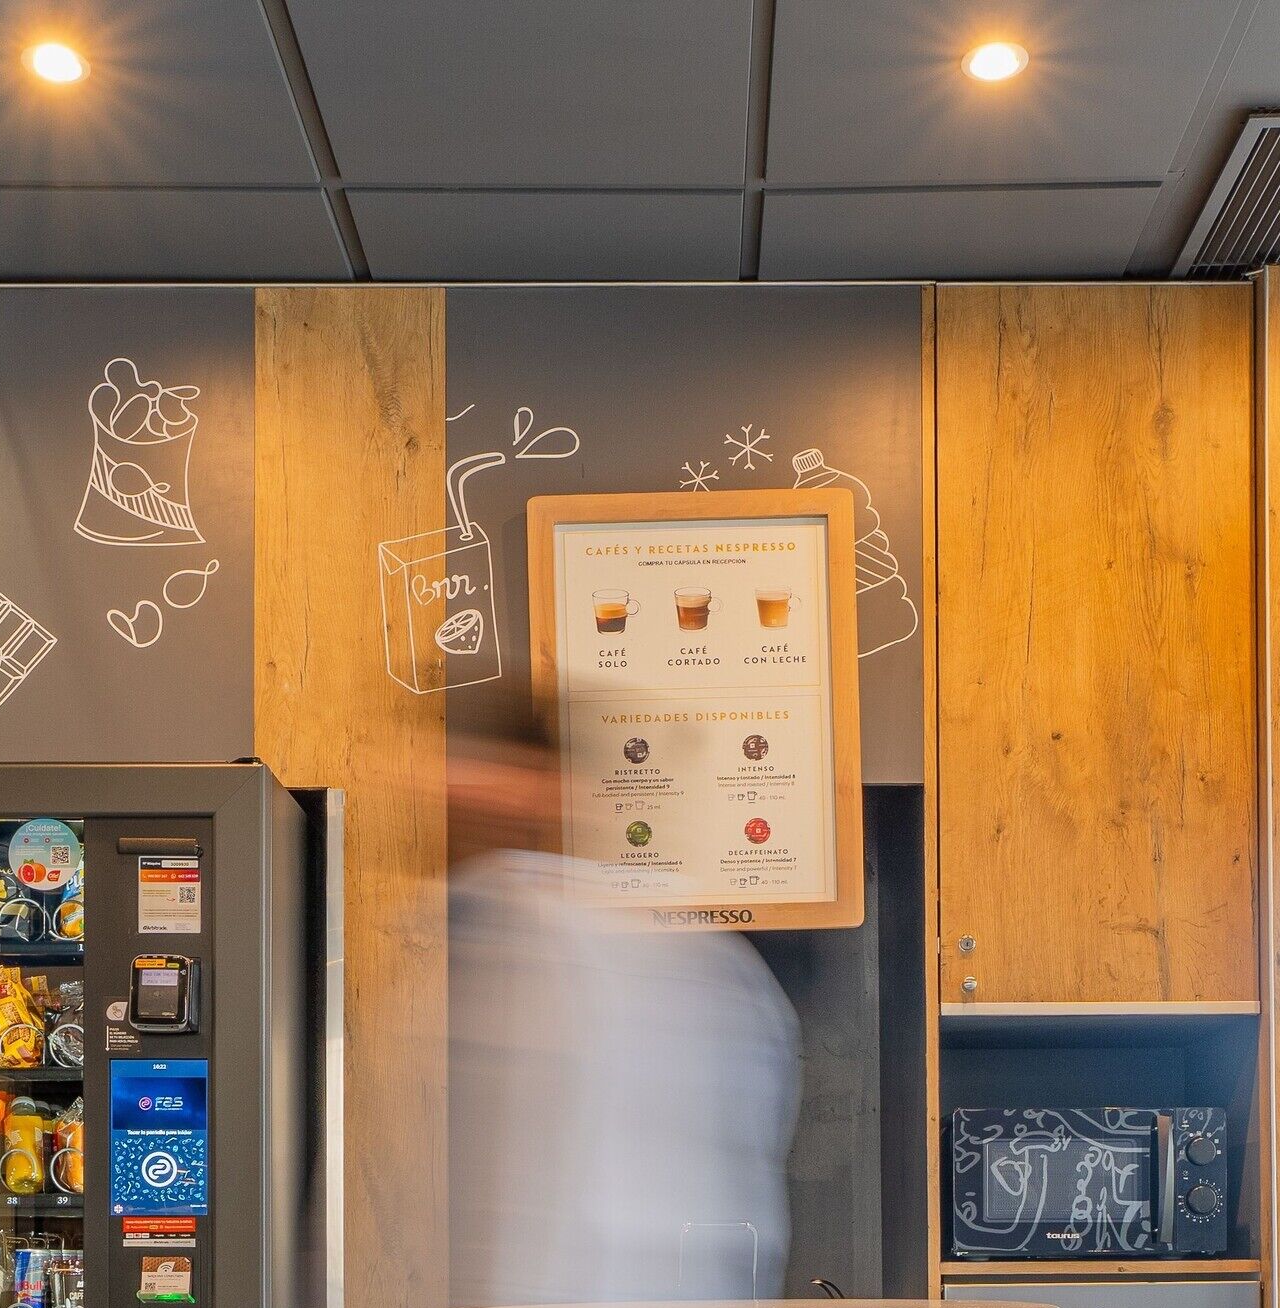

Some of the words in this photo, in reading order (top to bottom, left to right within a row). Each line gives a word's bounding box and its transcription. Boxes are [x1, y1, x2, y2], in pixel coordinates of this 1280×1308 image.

[586, 543, 628, 556] CAFÉS
[634, 546, 642, 555] Y
[648, 544, 709, 555] RECETAS
[715, 541, 796, 553] NESPRESSO
[599, 647, 626, 657] CAFÉ
[680, 645, 708, 655] CAFÉ
[761, 643, 789, 653] CAFÉ
[598, 660, 628, 668] SOLO
[667, 657, 721, 666] CORTADO
[743, 656, 767, 664] CON
[772, 655, 807, 664] LECHE
[601, 713, 689, 724] VARIEDADES
[695, 710, 789, 722] DISPONIBLES
[728, 848, 789, 856] DECAFFEINATO
[7, 1197, 18, 1205] 38
[57, 1197, 68, 1205] 39
[1045, 1231, 1080, 1239] taurus
